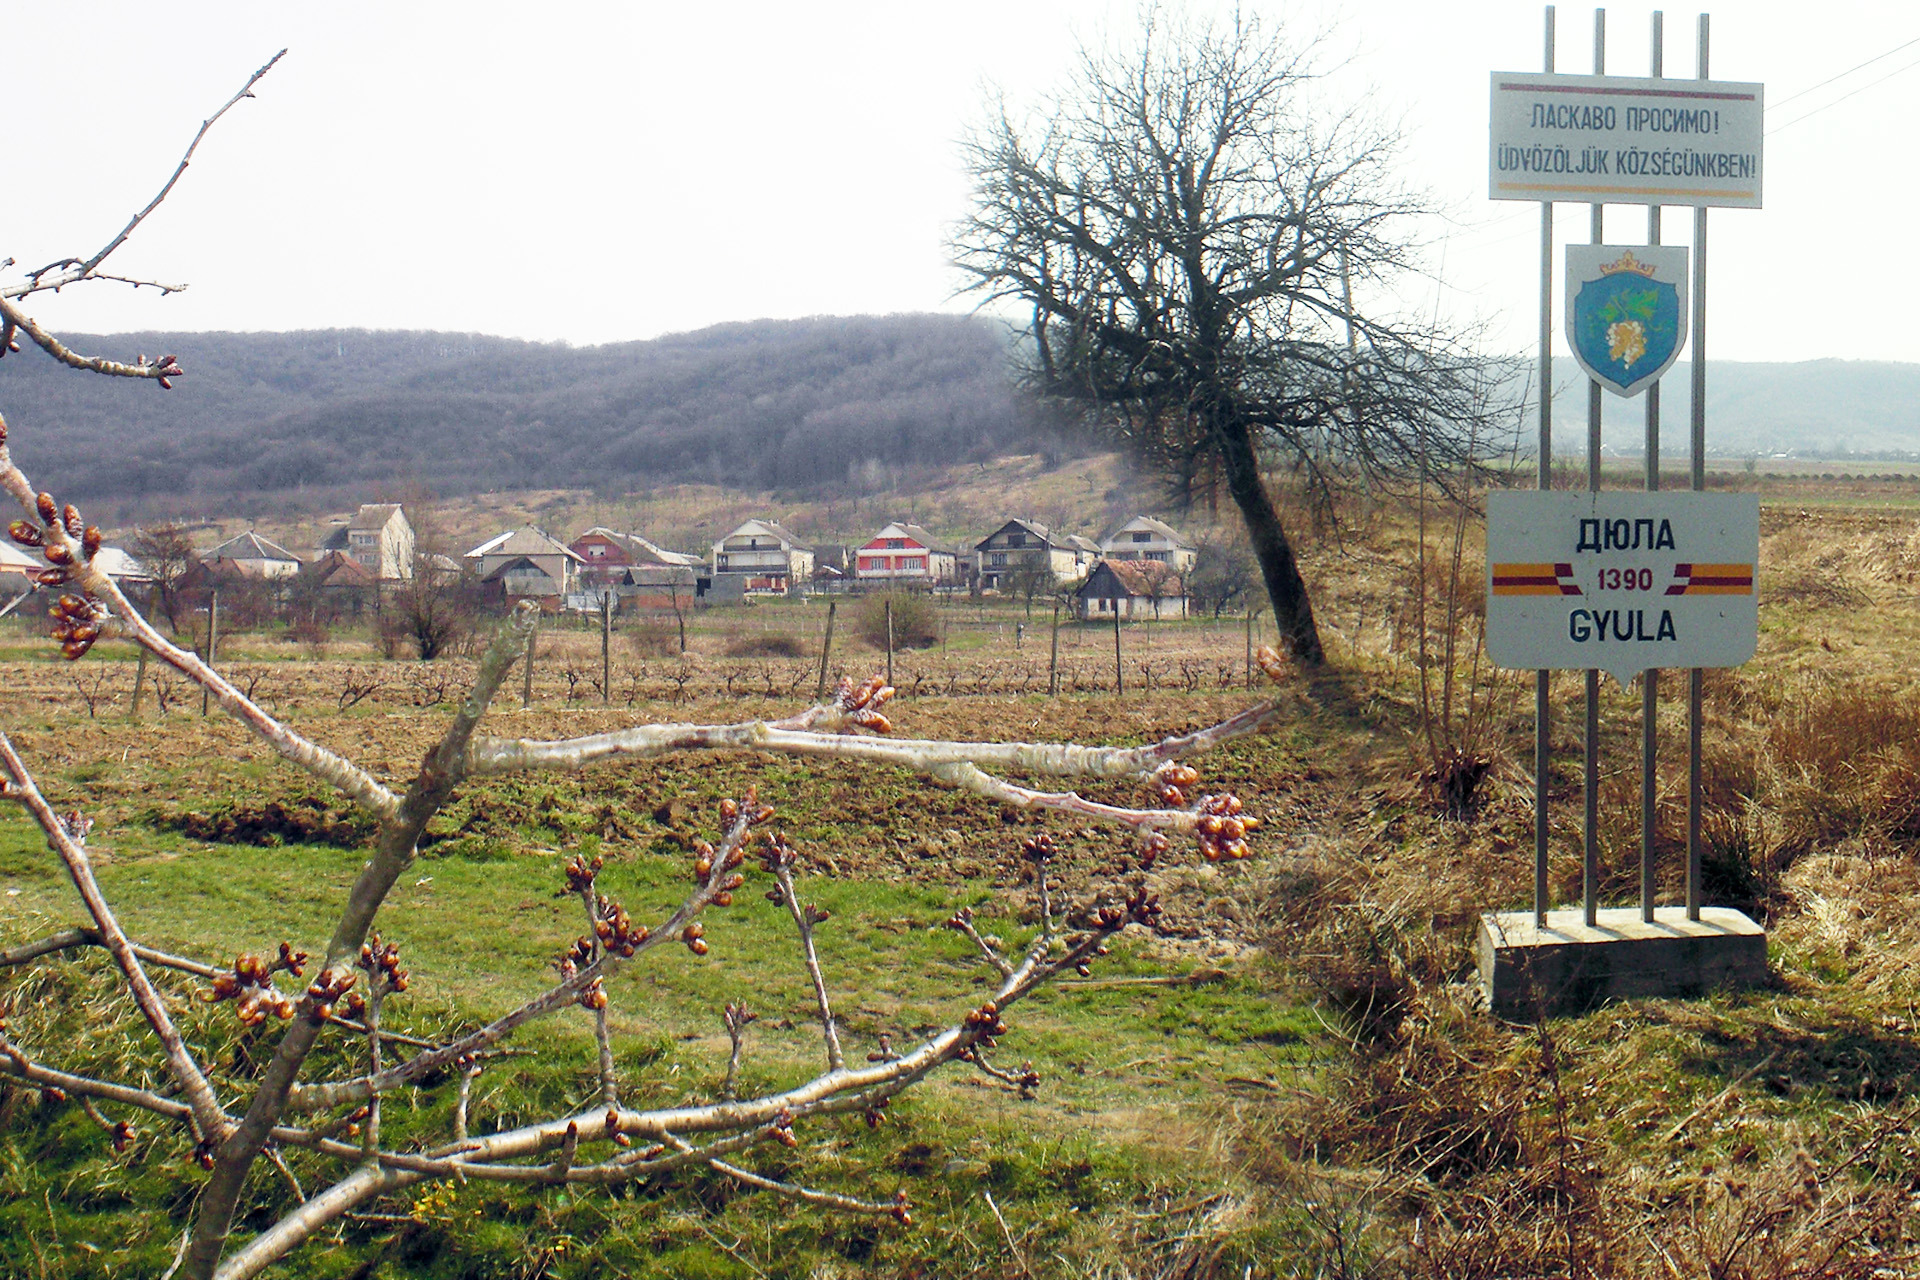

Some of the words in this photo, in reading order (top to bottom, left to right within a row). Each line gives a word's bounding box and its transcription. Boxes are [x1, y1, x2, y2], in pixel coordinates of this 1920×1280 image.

[1531, 103, 1616, 131] ЛАСКАВО
[1626, 106, 1719, 134] ПРОСИМО!
[1498, 143, 1609, 174] ÜDVÖZÖLJÜK
[1616, 146, 1756, 179] KÖZSÉGÜNKBEN!
[1576, 518, 1676, 554] ДЮЛА
[1597, 568, 1653, 592] 1390
[1568, 608, 1677, 643] GYULA
